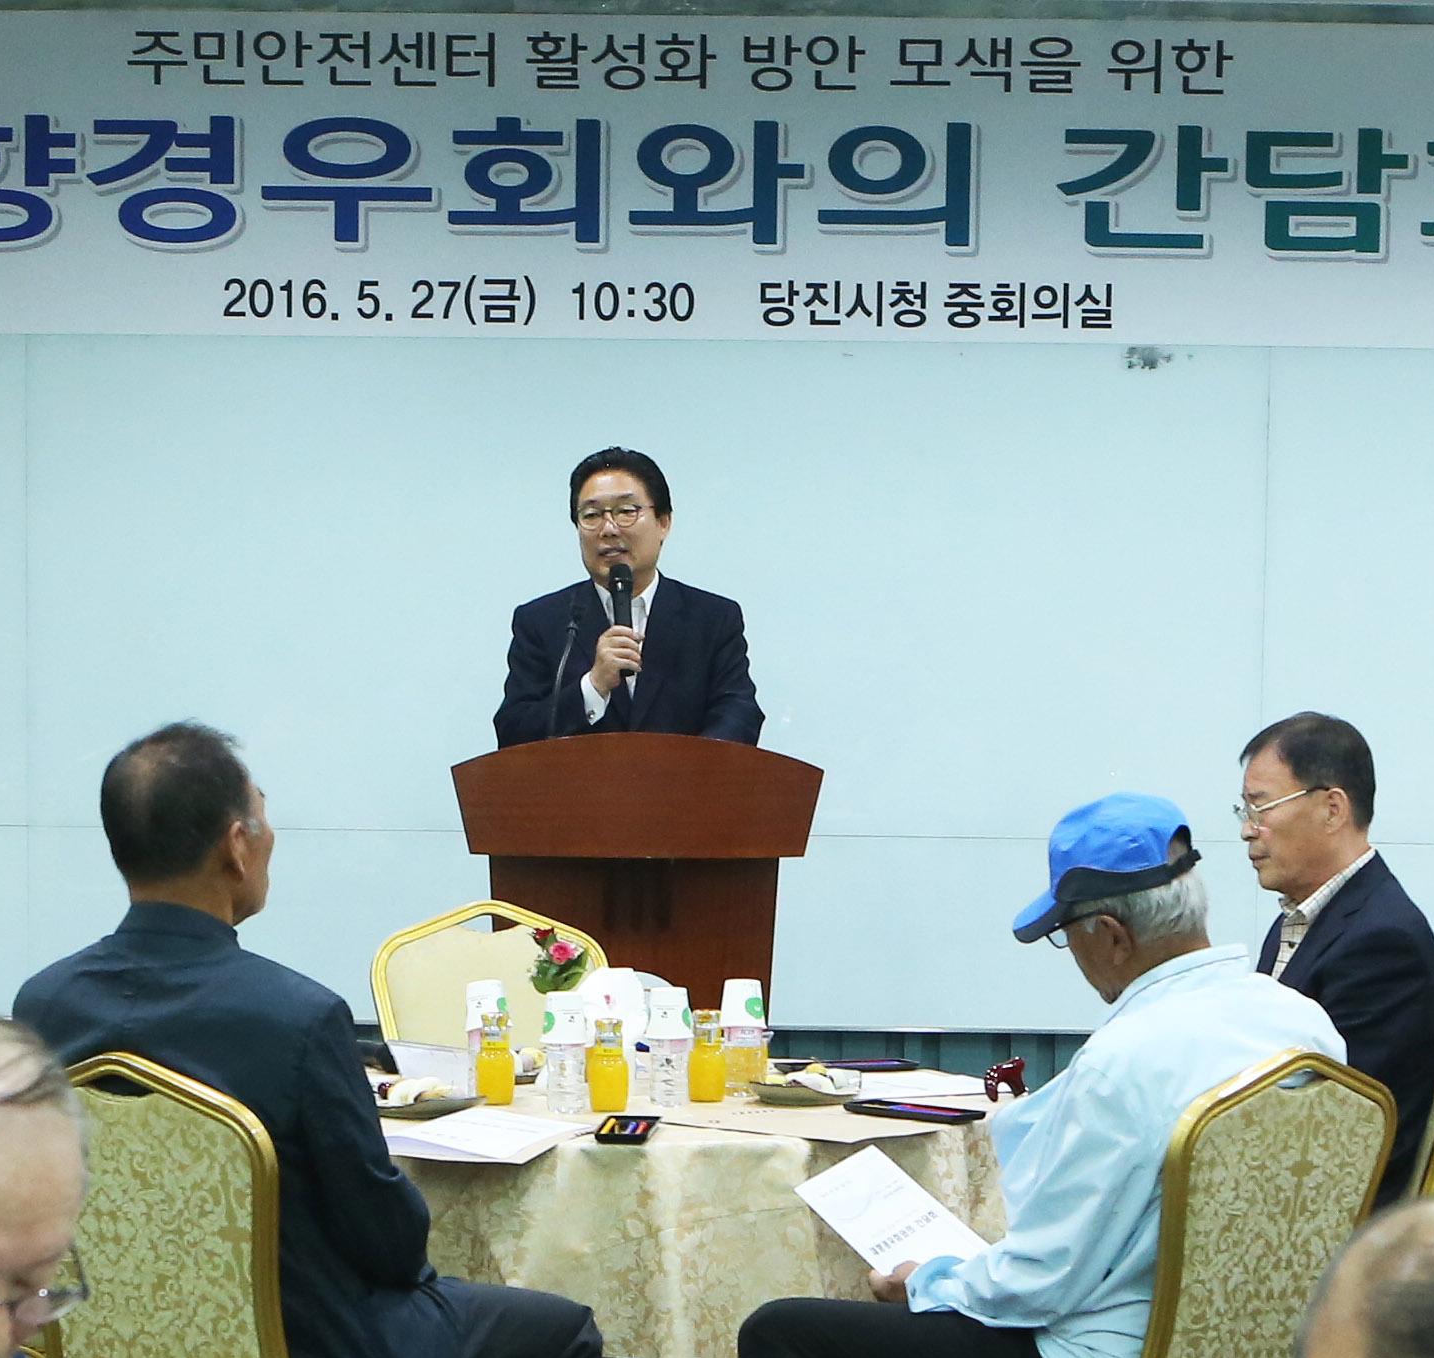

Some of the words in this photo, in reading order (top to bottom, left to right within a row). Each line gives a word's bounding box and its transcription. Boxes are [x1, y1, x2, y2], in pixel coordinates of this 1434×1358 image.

[126, 28, 496, 88] 주민안전센터
[525, 30, 718, 91] 활성화
[742, 34, 867, 92] 방안
[889, 36, 1082, 94] 모색을
[1106, 38, 1234, 95] 위한
[223, 278, 340, 321] 2016.
[410, 275, 536, 326] 27(금)
[571, 281, 695, 322] 10:30
[760, 279, 927, 328] 당진시청
[943, 282, 1112, 329] 중회의실
